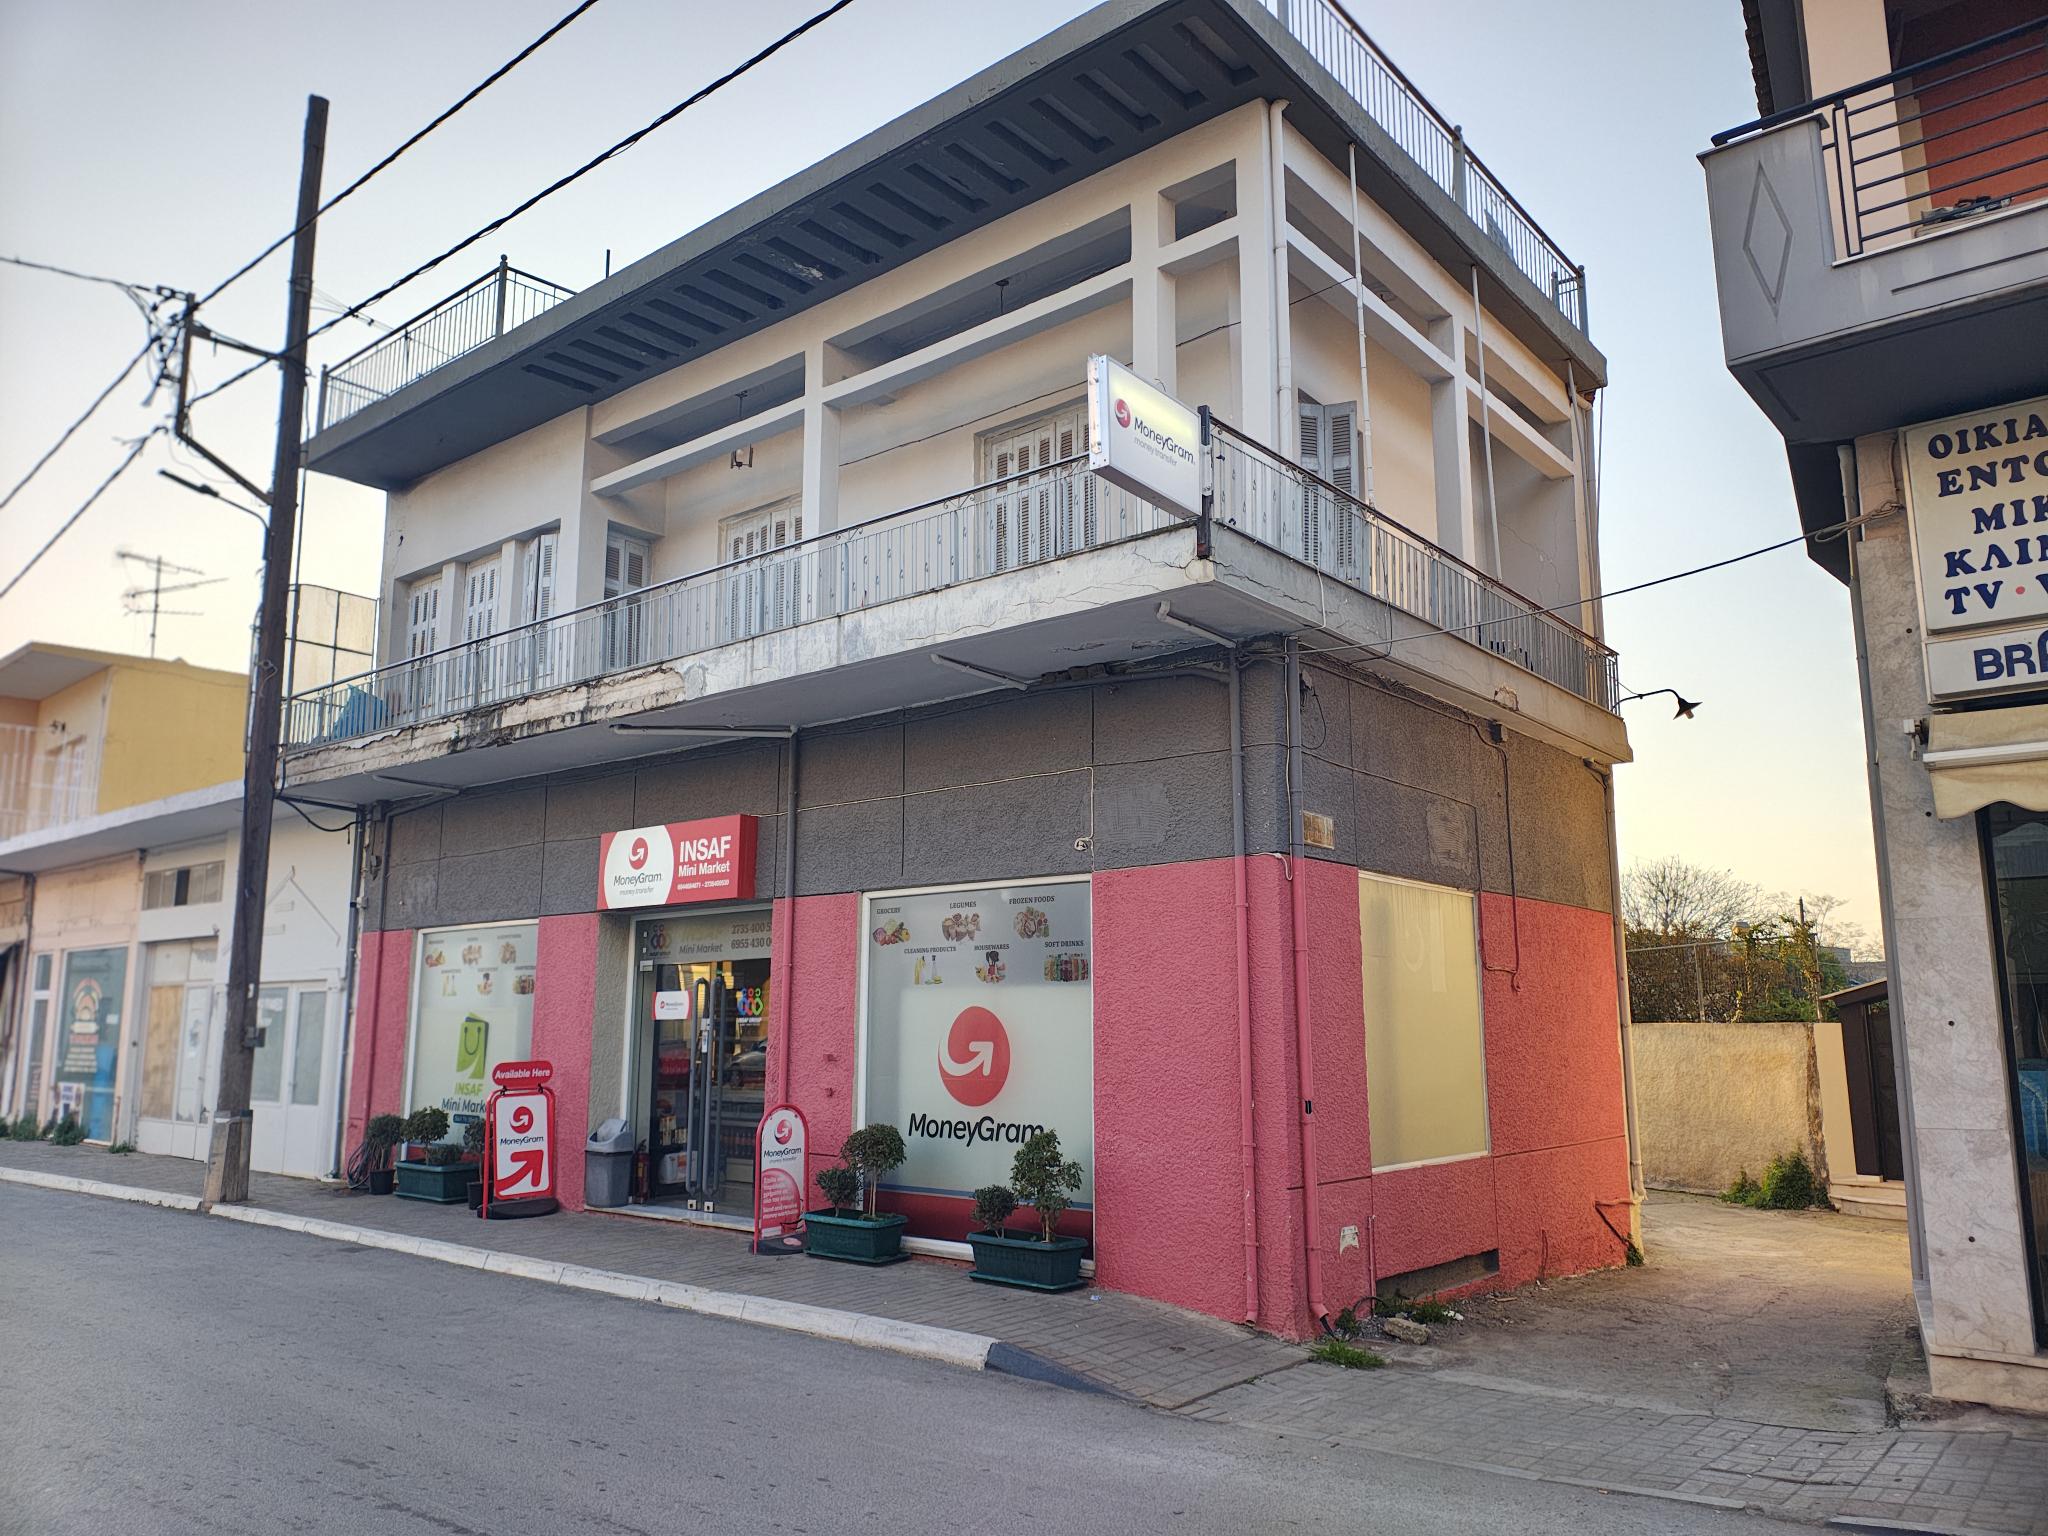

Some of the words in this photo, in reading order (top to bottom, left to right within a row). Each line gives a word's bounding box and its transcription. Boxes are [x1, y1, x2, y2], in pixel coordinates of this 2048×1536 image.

[1134, 417, 1194, 463] MoneyGram
[1945, 581, 2003, 614] TV
[680, 835, 731, 862] INSAF
[678, 864, 696, 877] Mini
[699, 860, 730, 875] Market
[613, 872, 662, 886] MoneyGram
[950, 901, 977, 909] LEGUMES
[1009, 897, 1033, 905] FROZEN
[679, 945, 695, 954] Mini
[696, 943, 722, 954] Market
[1060, 939, 1084, 947] DRINKS
[495, 1068, 531, 1079] Available
[531, 1067, 551, 1077] Here
[455, 1082, 483, 1096] INSAF
[441, 1097, 461, 1111] Mini
[500, 1136, 544, 1146] MoneyGram
[764, 1148, 802, 1157] MoneyGram
